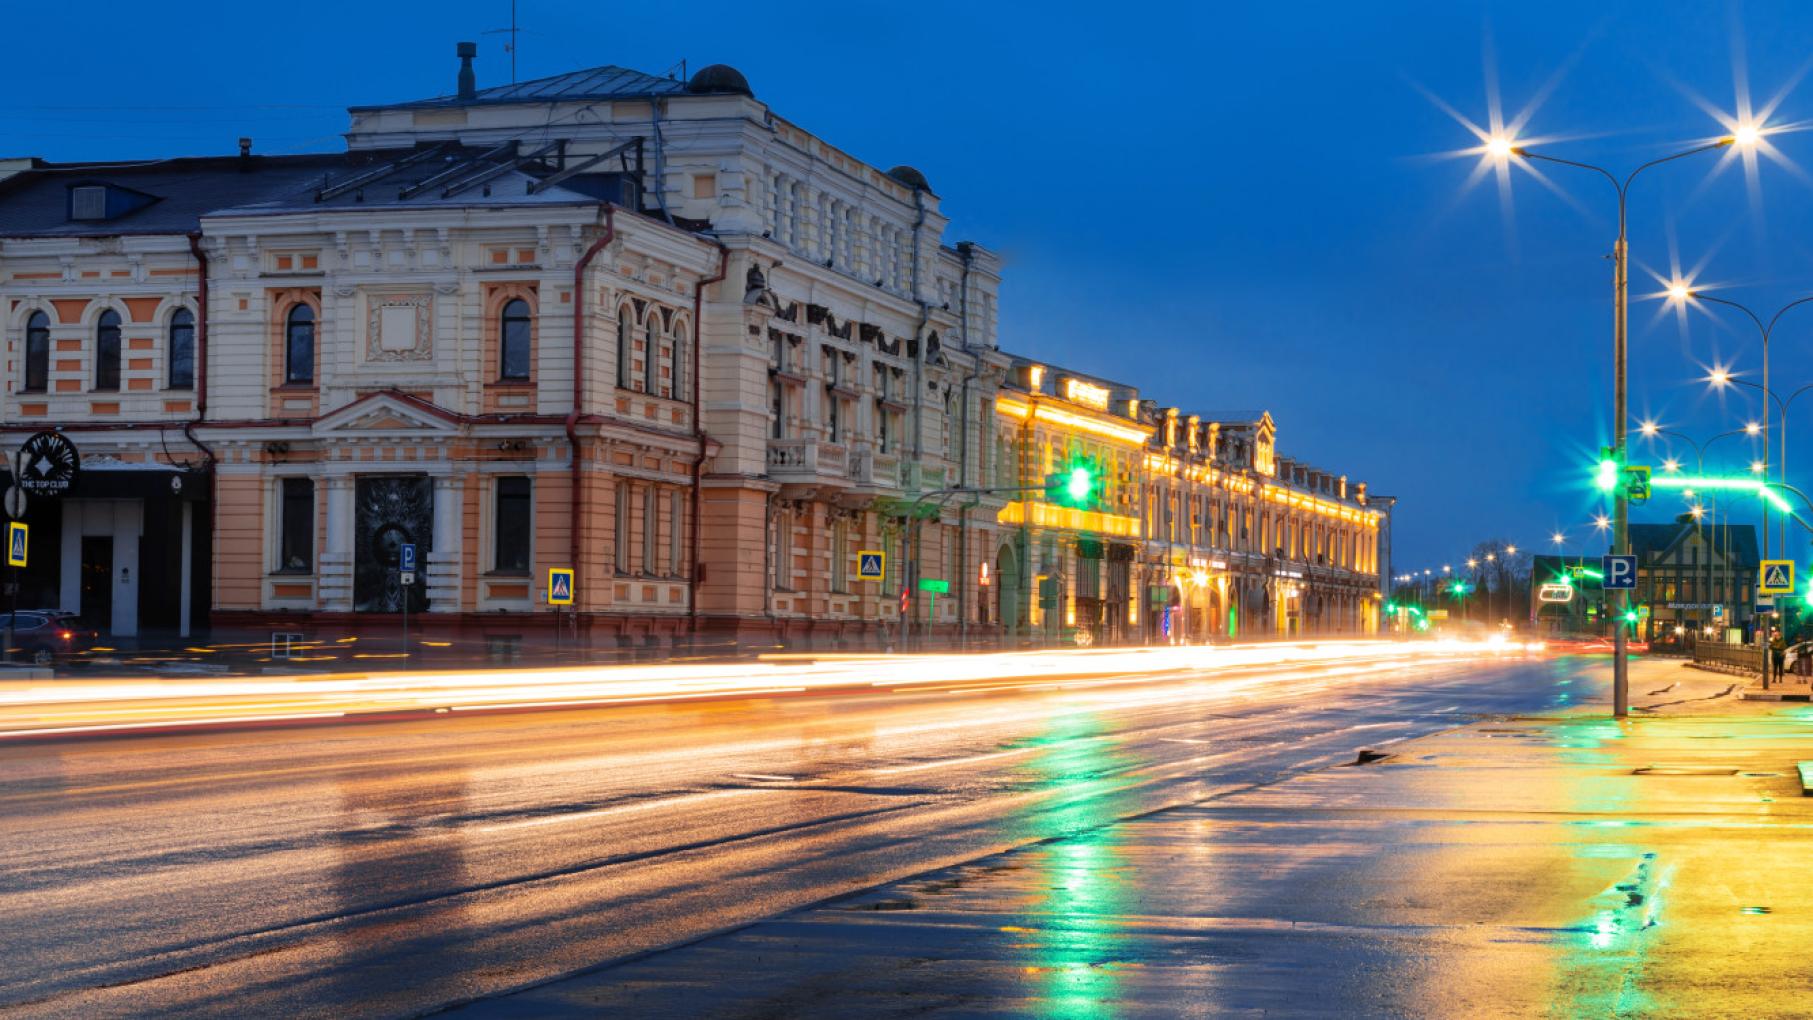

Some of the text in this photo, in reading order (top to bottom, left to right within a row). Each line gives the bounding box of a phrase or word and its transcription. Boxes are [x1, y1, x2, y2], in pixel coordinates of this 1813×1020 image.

[36, 480, 49, 488] TOP
[50, 480, 69, 489] CLUB
[405, 547, 413, 568] P
[1611, 558, 1630, 585] P
